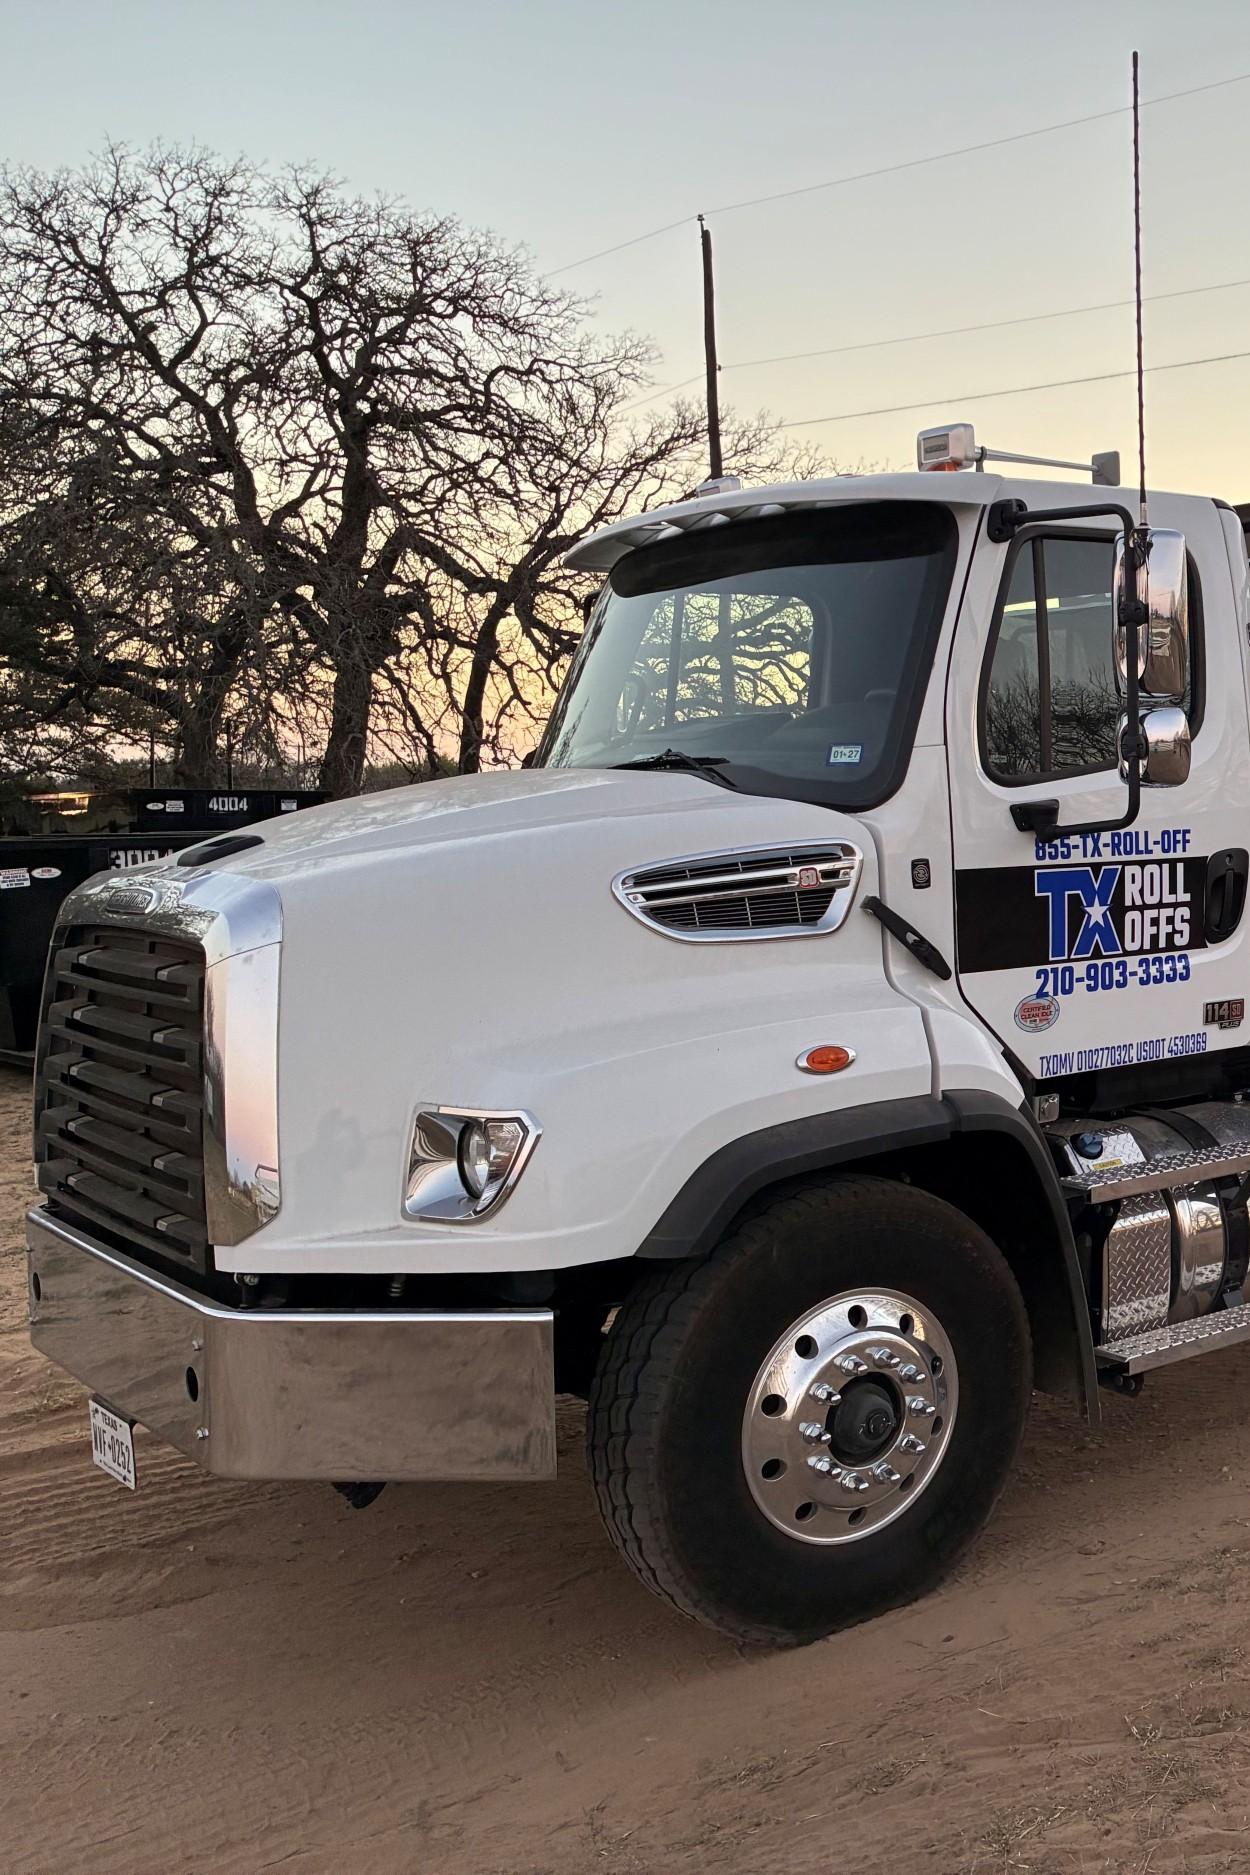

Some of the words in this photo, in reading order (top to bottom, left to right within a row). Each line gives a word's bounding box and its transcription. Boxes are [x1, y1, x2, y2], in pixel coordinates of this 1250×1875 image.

[208, 797, 248, 811] 4004
[110, 849, 174, 870] 300
[1035, 829, 1191, 861] 855-TX-ROLL-OFF
[1034, 865, 1123, 961] TX
[1124, 862, 1191, 907] ROLL
[1124, 906, 1191, 952] OFFS
[1035, 953, 1191, 999] 210-903-3333
[1207, 1002, 1230, 1022] 114
[1039, 1052, 1075, 1077] TXDMV
[1077, 1043, 1134, 1071] 010277032C
[1136, 1038, 1166, 1062] USDOT
[1167, 1032, 1207, 1057] 4530369
[100, 1411, 118, 1432] TEXAS
